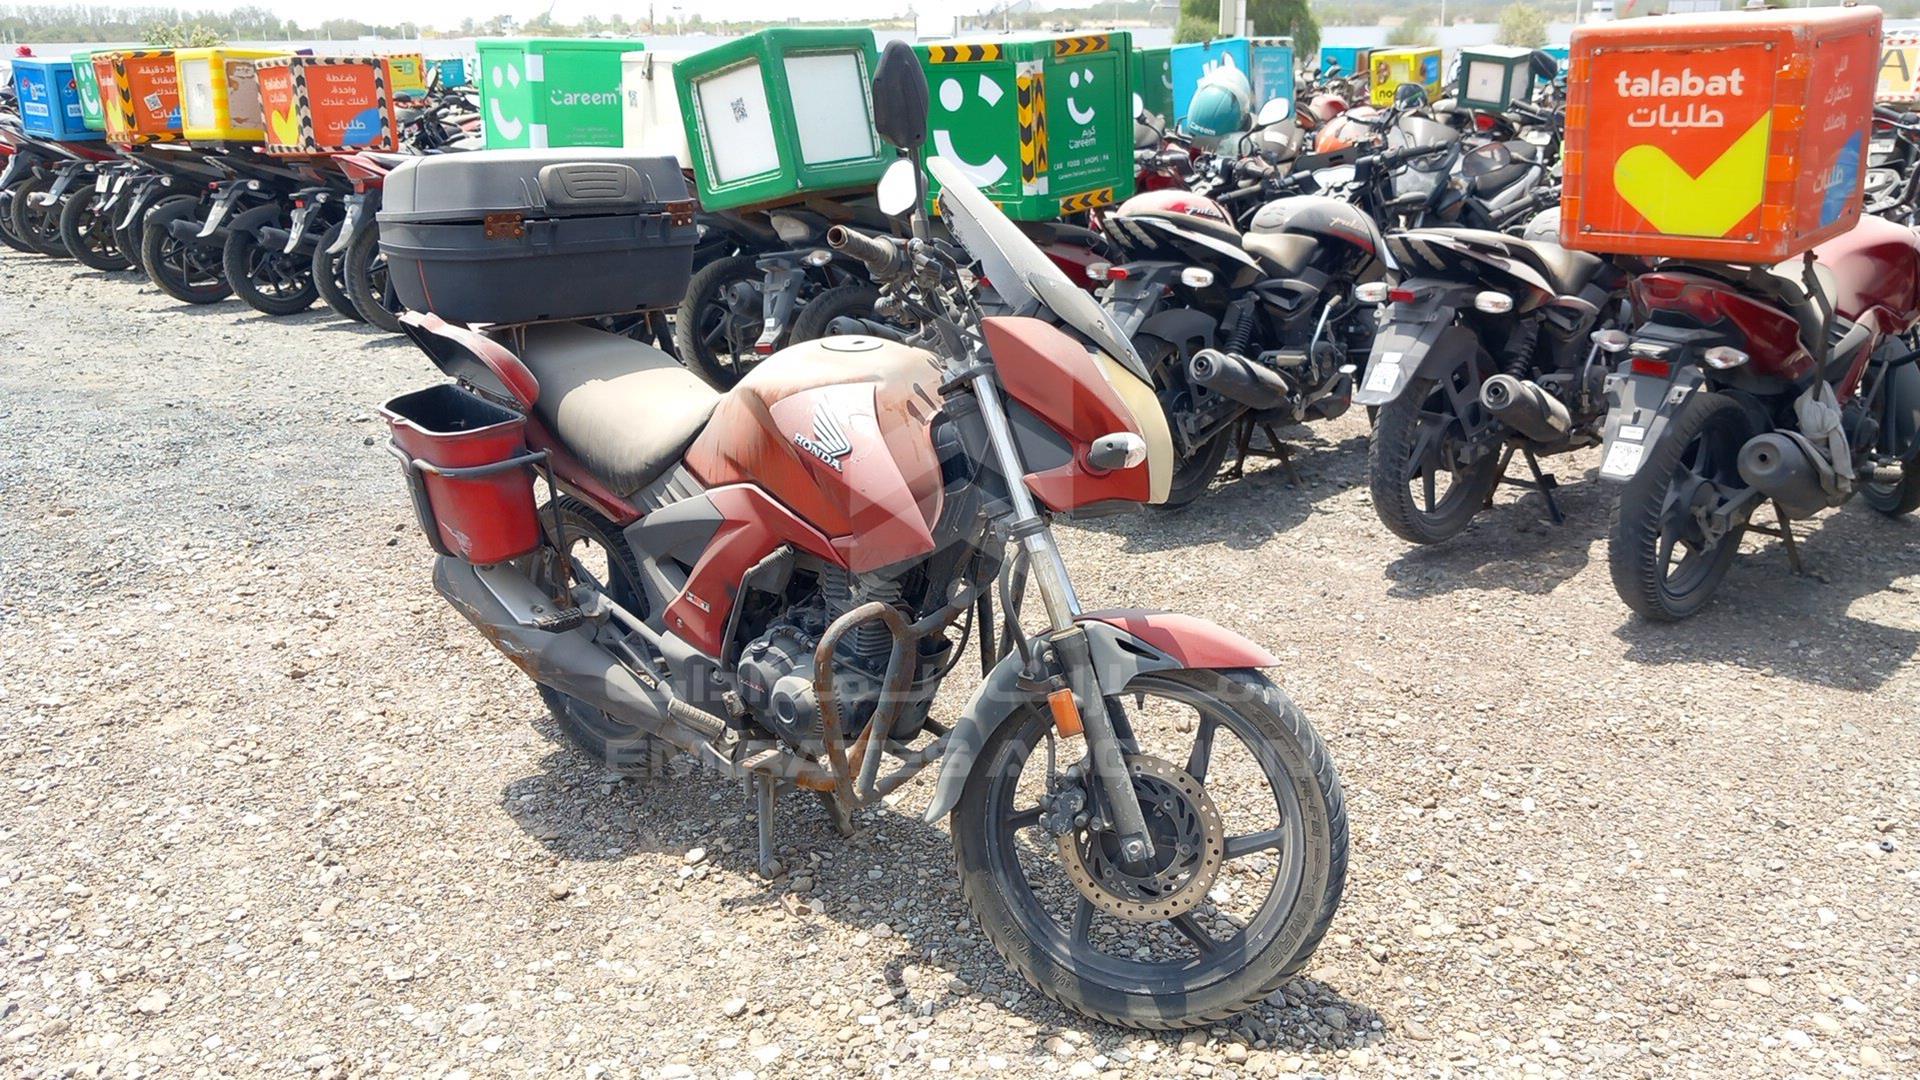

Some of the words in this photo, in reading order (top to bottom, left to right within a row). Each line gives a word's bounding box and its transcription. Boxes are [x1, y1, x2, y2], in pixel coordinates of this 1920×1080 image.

[1614, 67, 1745, 97] talabat
[152, 108, 181, 120] لبات
[328, 120, 366, 131] طلبات
[1627, 103, 1724, 136] طلبات
[794, 432, 843, 473] HONDA
